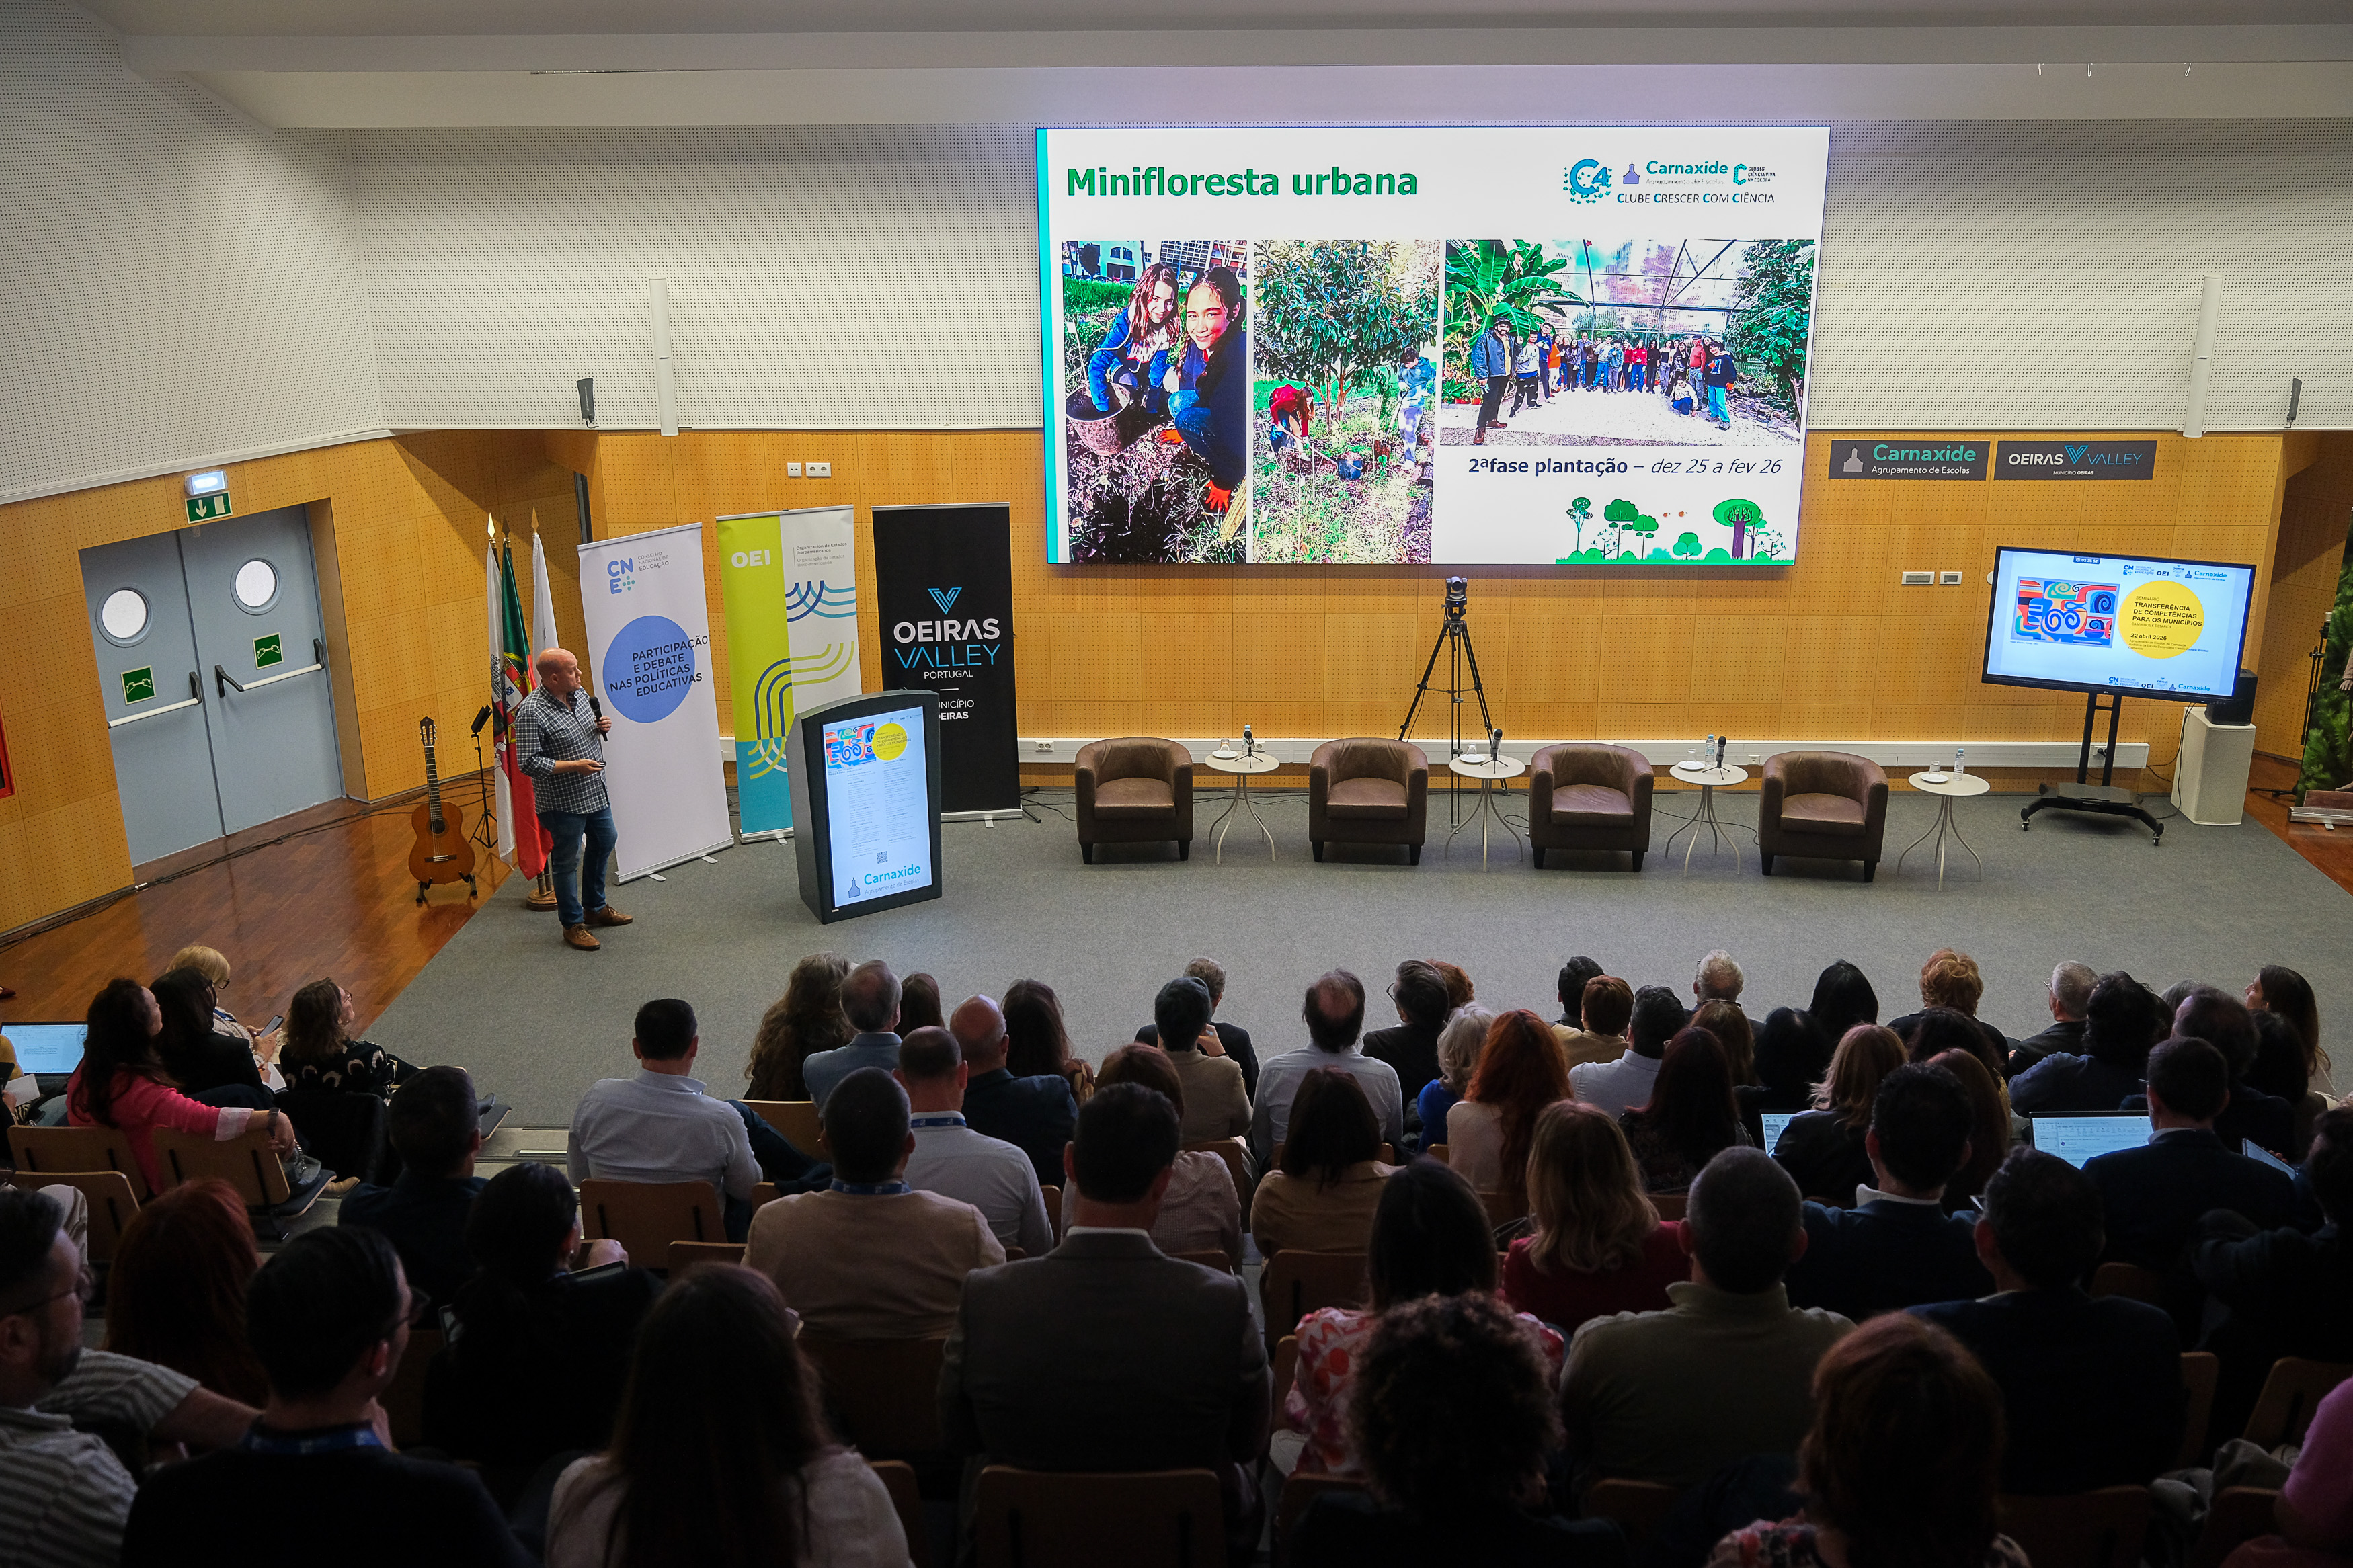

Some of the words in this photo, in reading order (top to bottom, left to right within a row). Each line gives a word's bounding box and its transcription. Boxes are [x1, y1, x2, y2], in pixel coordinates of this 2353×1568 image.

[1646, 161, 1728, 175] Carnaxide
[1068, 167, 1279, 196] Minifloresta
[1292, 167, 1417, 196] urbana
[1617, 193, 1650, 203] CLUBE
[1653, 193, 1700, 203] CRESCER
[1702, 193, 1729, 203] COM
[1732, 192, 1775, 203] CIÊNCIA
[1873, 444, 1976, 461] Carnaxide
[2008, 454, 2063, 465] OEIRAS
[2087, 453, 2143, 465] VALLEY
[1468, 458, 1529, 473] 2ªfase
[1535, 458, 1628, 477] plantação
[1651, 458, 1681, 474] dez
[1685, 459, 1708, 474] 25
[1712, 462, 1723, 474] a
[1727, 458, 1755, 474] fev
[1759, 459, 1782, 474] 26
[1871, 466, 1927, 475] Agrupamento
[1942, 466, 1970, 474] Escolas
[637, 551, 662, 561] CONSELHO
[638, 557, 662, 565] NACIONAL
[731, 549, 771, 568] OEI
[607, 557, 633, 577] CN
[639, 560, 669, 571] EDUCAÇÃO
[2194, 570, 2227, 578] Carnaxide
[2135, 602, 2190, 611] TRANSFERÊNCIA
[2144, 610, 2197, 619] COMPETÊNCIAS
[2163, 618, 2202, 626] MUNICÍPIOS
[893, 618, 1000, 643] OEIRAS
[632, 634, 708, 661] PARTICIPAÇÃO
[634, 664, 640, 673] E
[643, 653, 684, 671] DEBATE
[894, 644, 1000, 669] VALLEY
[610, 678, 633, 692] NAS
[635, 662, 690, 686] POLÍTICAS
[924, 670, 973, 679] PORTUGAL
[636, 673, 703, 697] EDUCATIVAS
[2178, 683, 2210, 692] Carnaxide
[939, 699, 975, 709] NICÍPIO
[939, 711, 969, 720] EIRAS
[864, 864, 921, 885] Carnaxide
[865, 883, 896, 895] Agrupamento
[903, 878, 920, 886] Escolas
